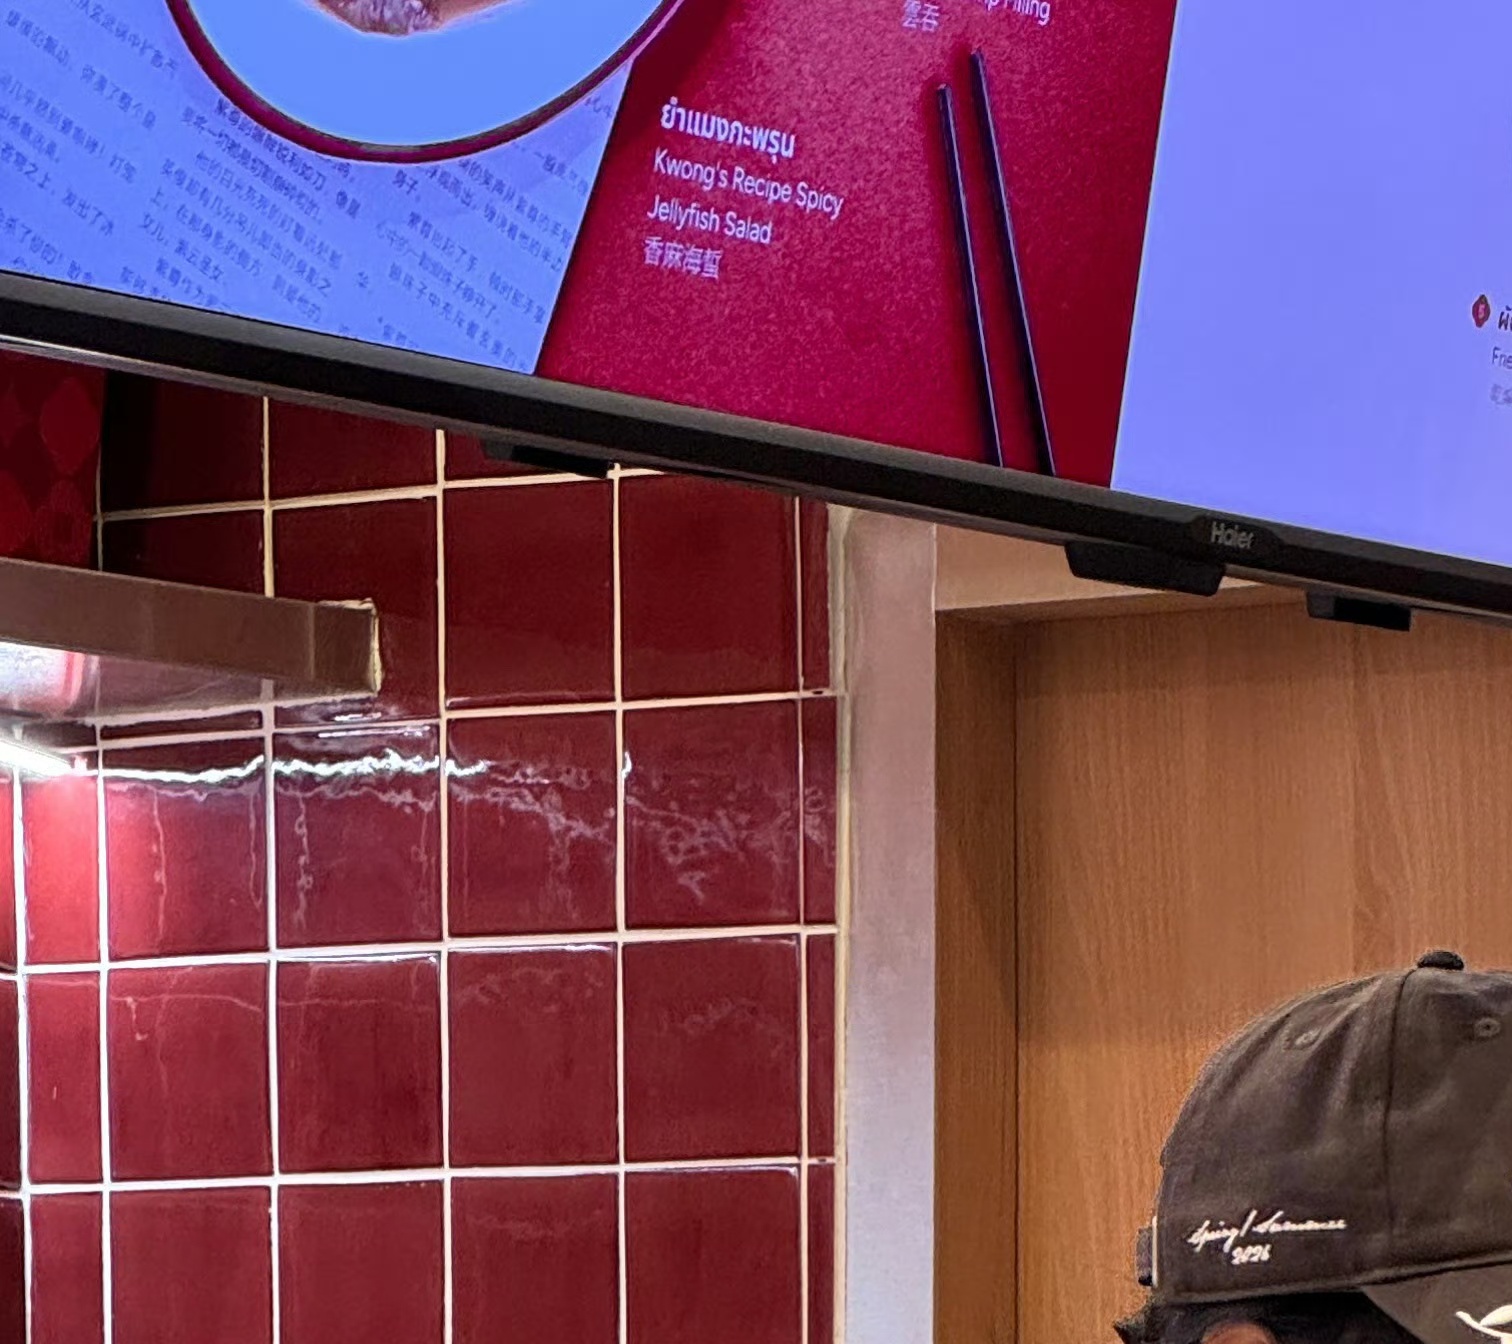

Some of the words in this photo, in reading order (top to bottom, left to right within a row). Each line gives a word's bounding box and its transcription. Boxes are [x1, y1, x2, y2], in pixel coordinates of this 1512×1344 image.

[660, 96, 797, 164] ยำแมงกะพรุน
[654, 146, 729, 191] Kwong's
[732, 165, 793, 204] Recipe
[796, 181, 845, 220] Spicy
[647, 194, 721, 231] Jellyfish
[724, 210, 774, 244] Salad
[1210, 521, 1254, 548] Haier
